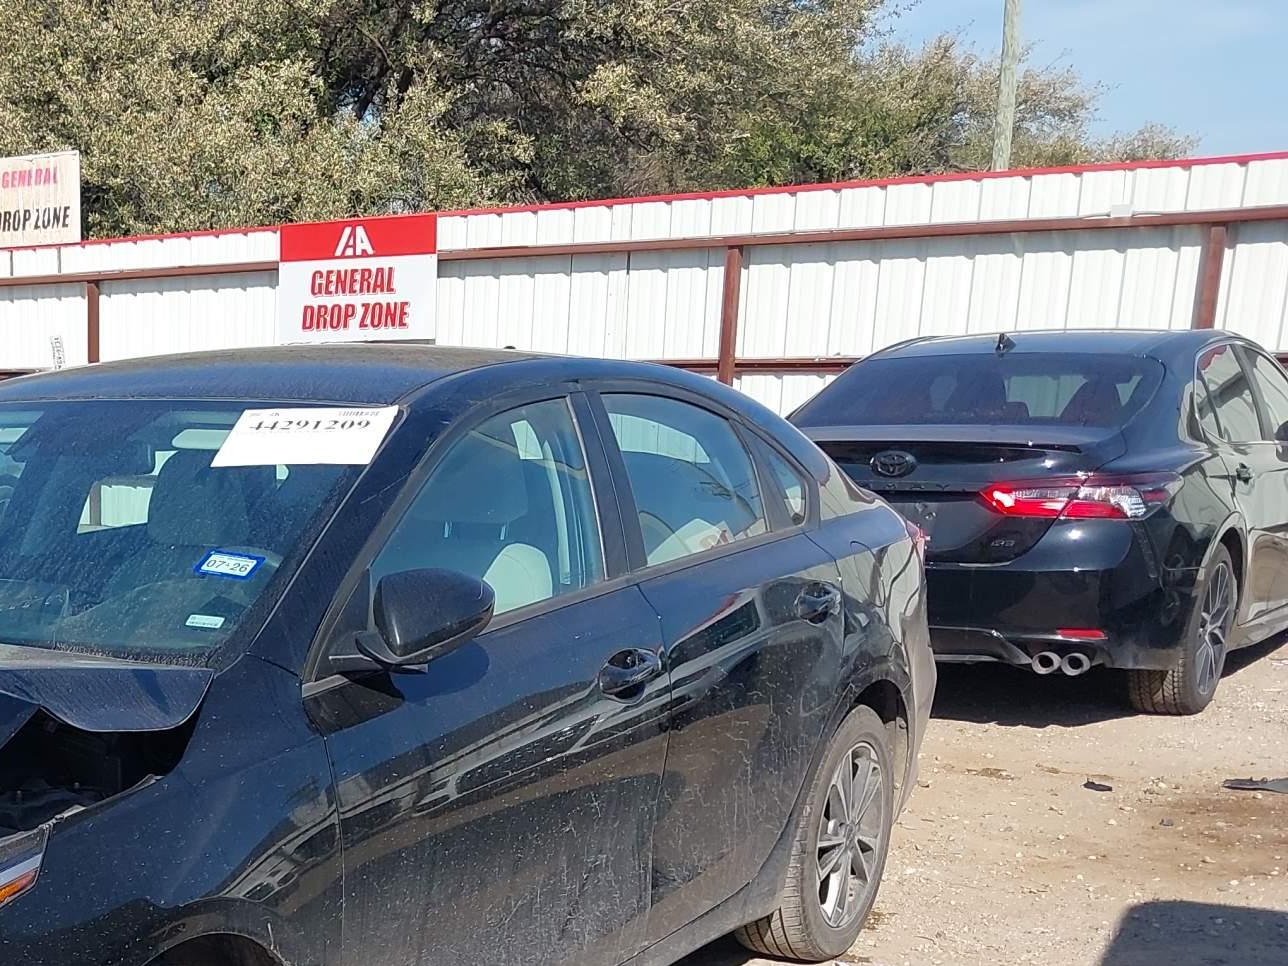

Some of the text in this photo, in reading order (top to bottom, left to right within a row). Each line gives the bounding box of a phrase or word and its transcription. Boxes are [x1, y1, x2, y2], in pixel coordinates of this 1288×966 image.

[33, 205, 71, 231] ZONE
[311, 267, 396, 297] GENERAL
[302, 301, 410, 331] DROP ZONE
[248, 419, 372, 432] 44291209
